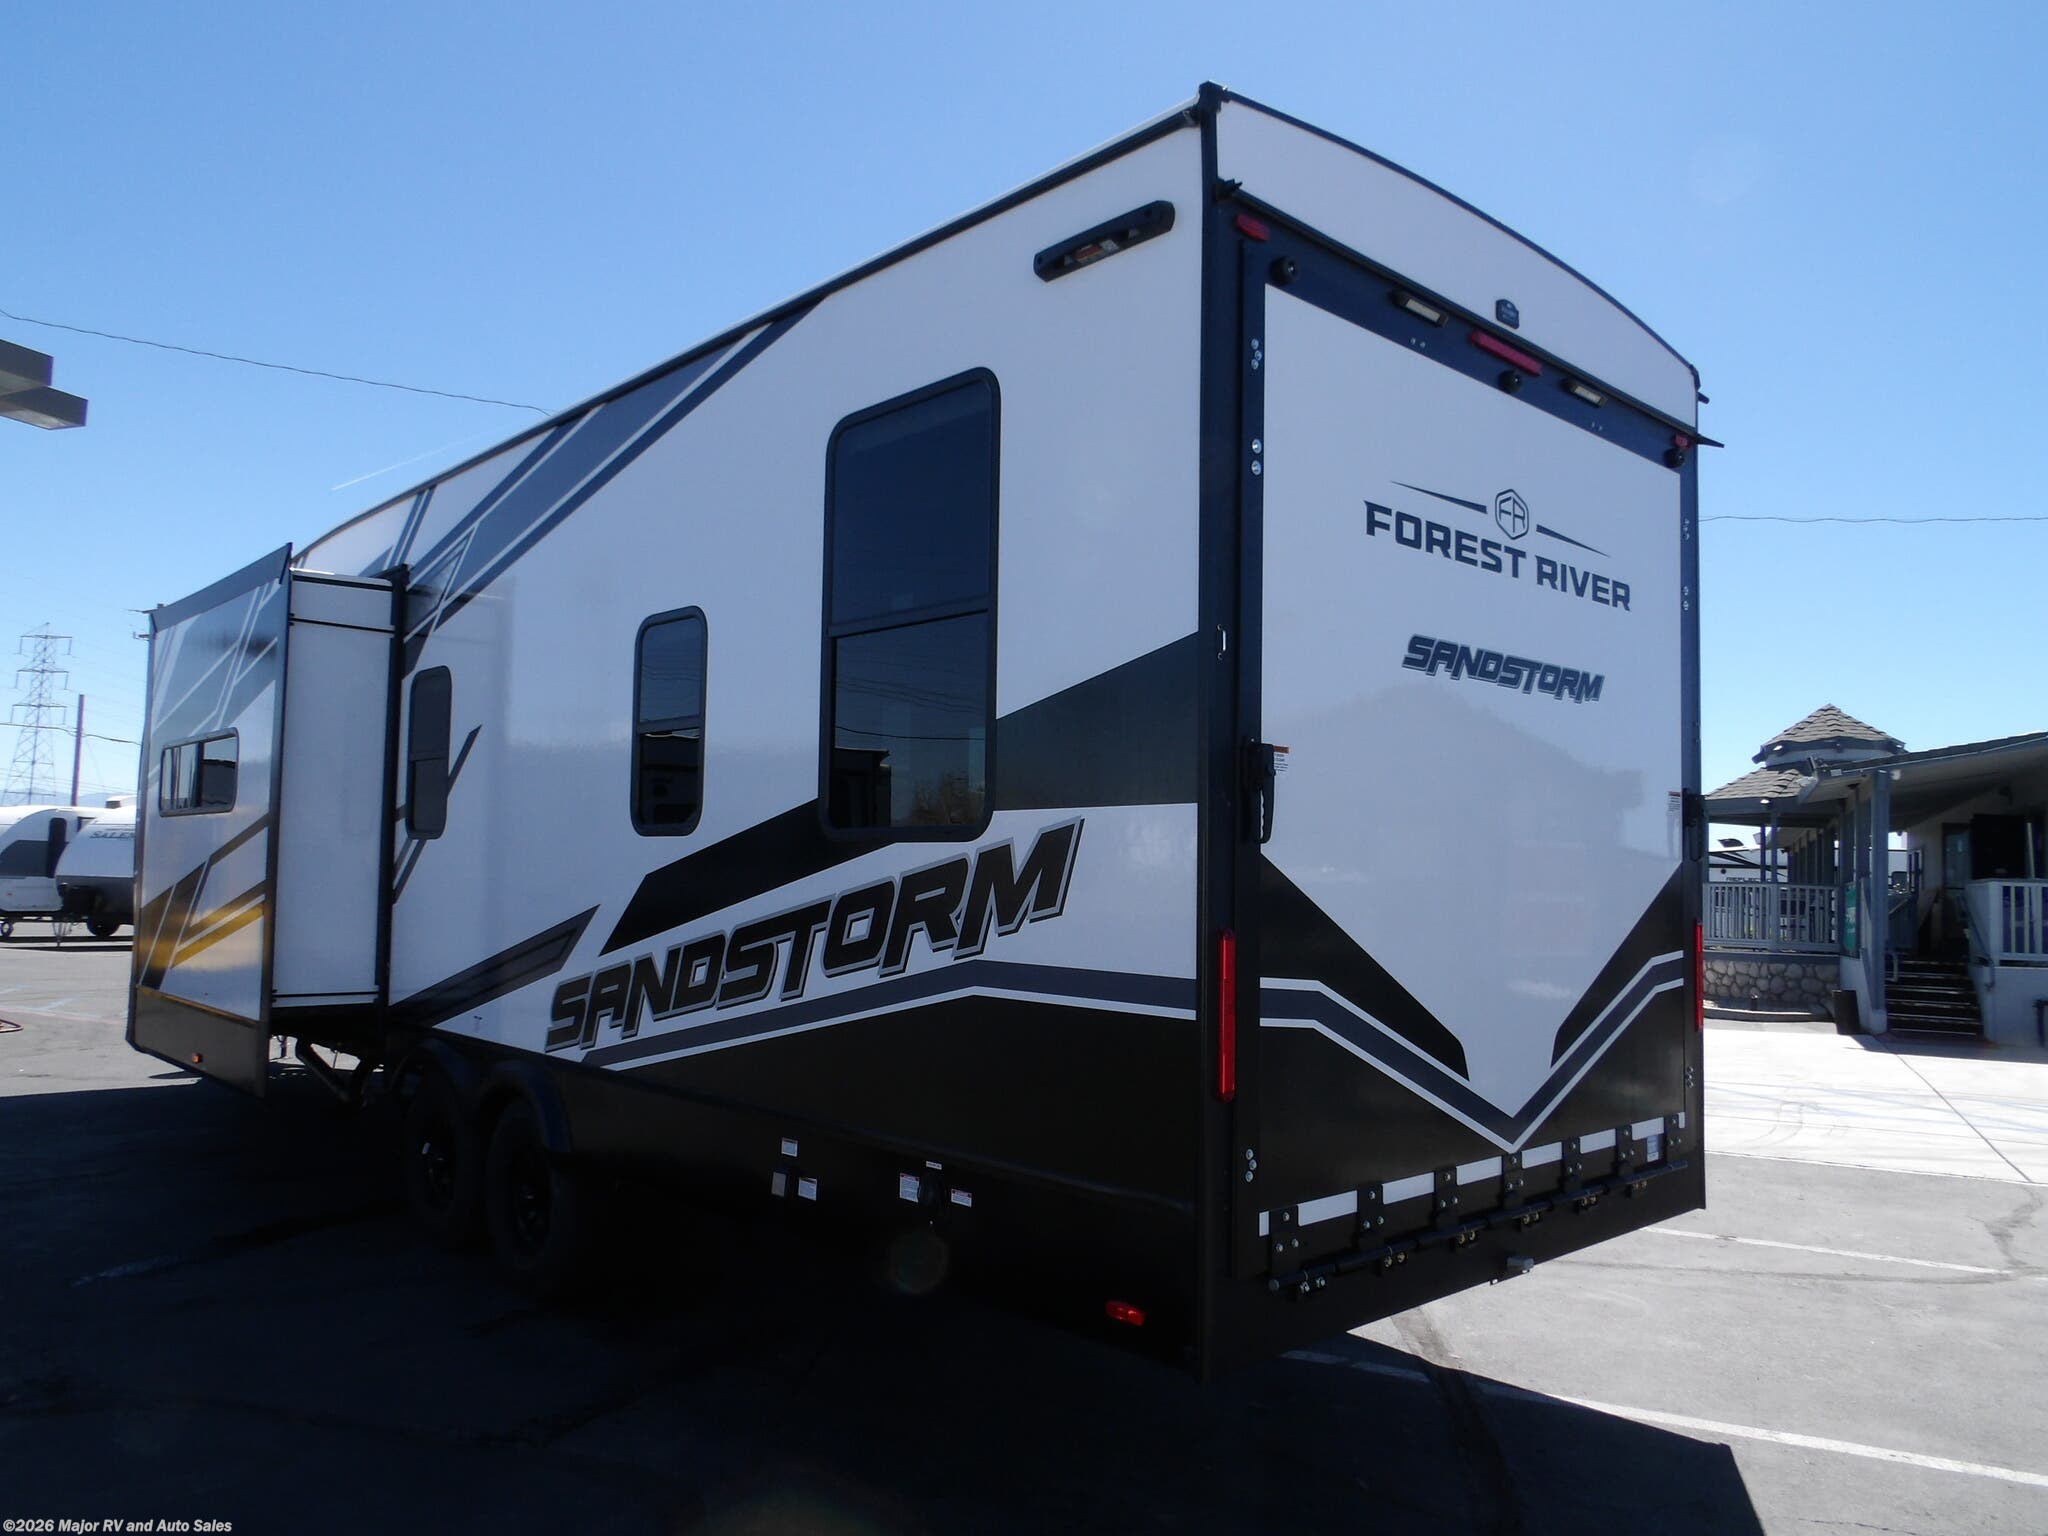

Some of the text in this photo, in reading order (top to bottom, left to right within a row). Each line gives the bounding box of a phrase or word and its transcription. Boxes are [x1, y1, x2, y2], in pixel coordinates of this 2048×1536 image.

[1363, 499, 1631, 612] FOREST RIVER
[1401, 633, 1605, 705] SANDSTORM
[545, 815, 1085, 1053] SANDSTORM
